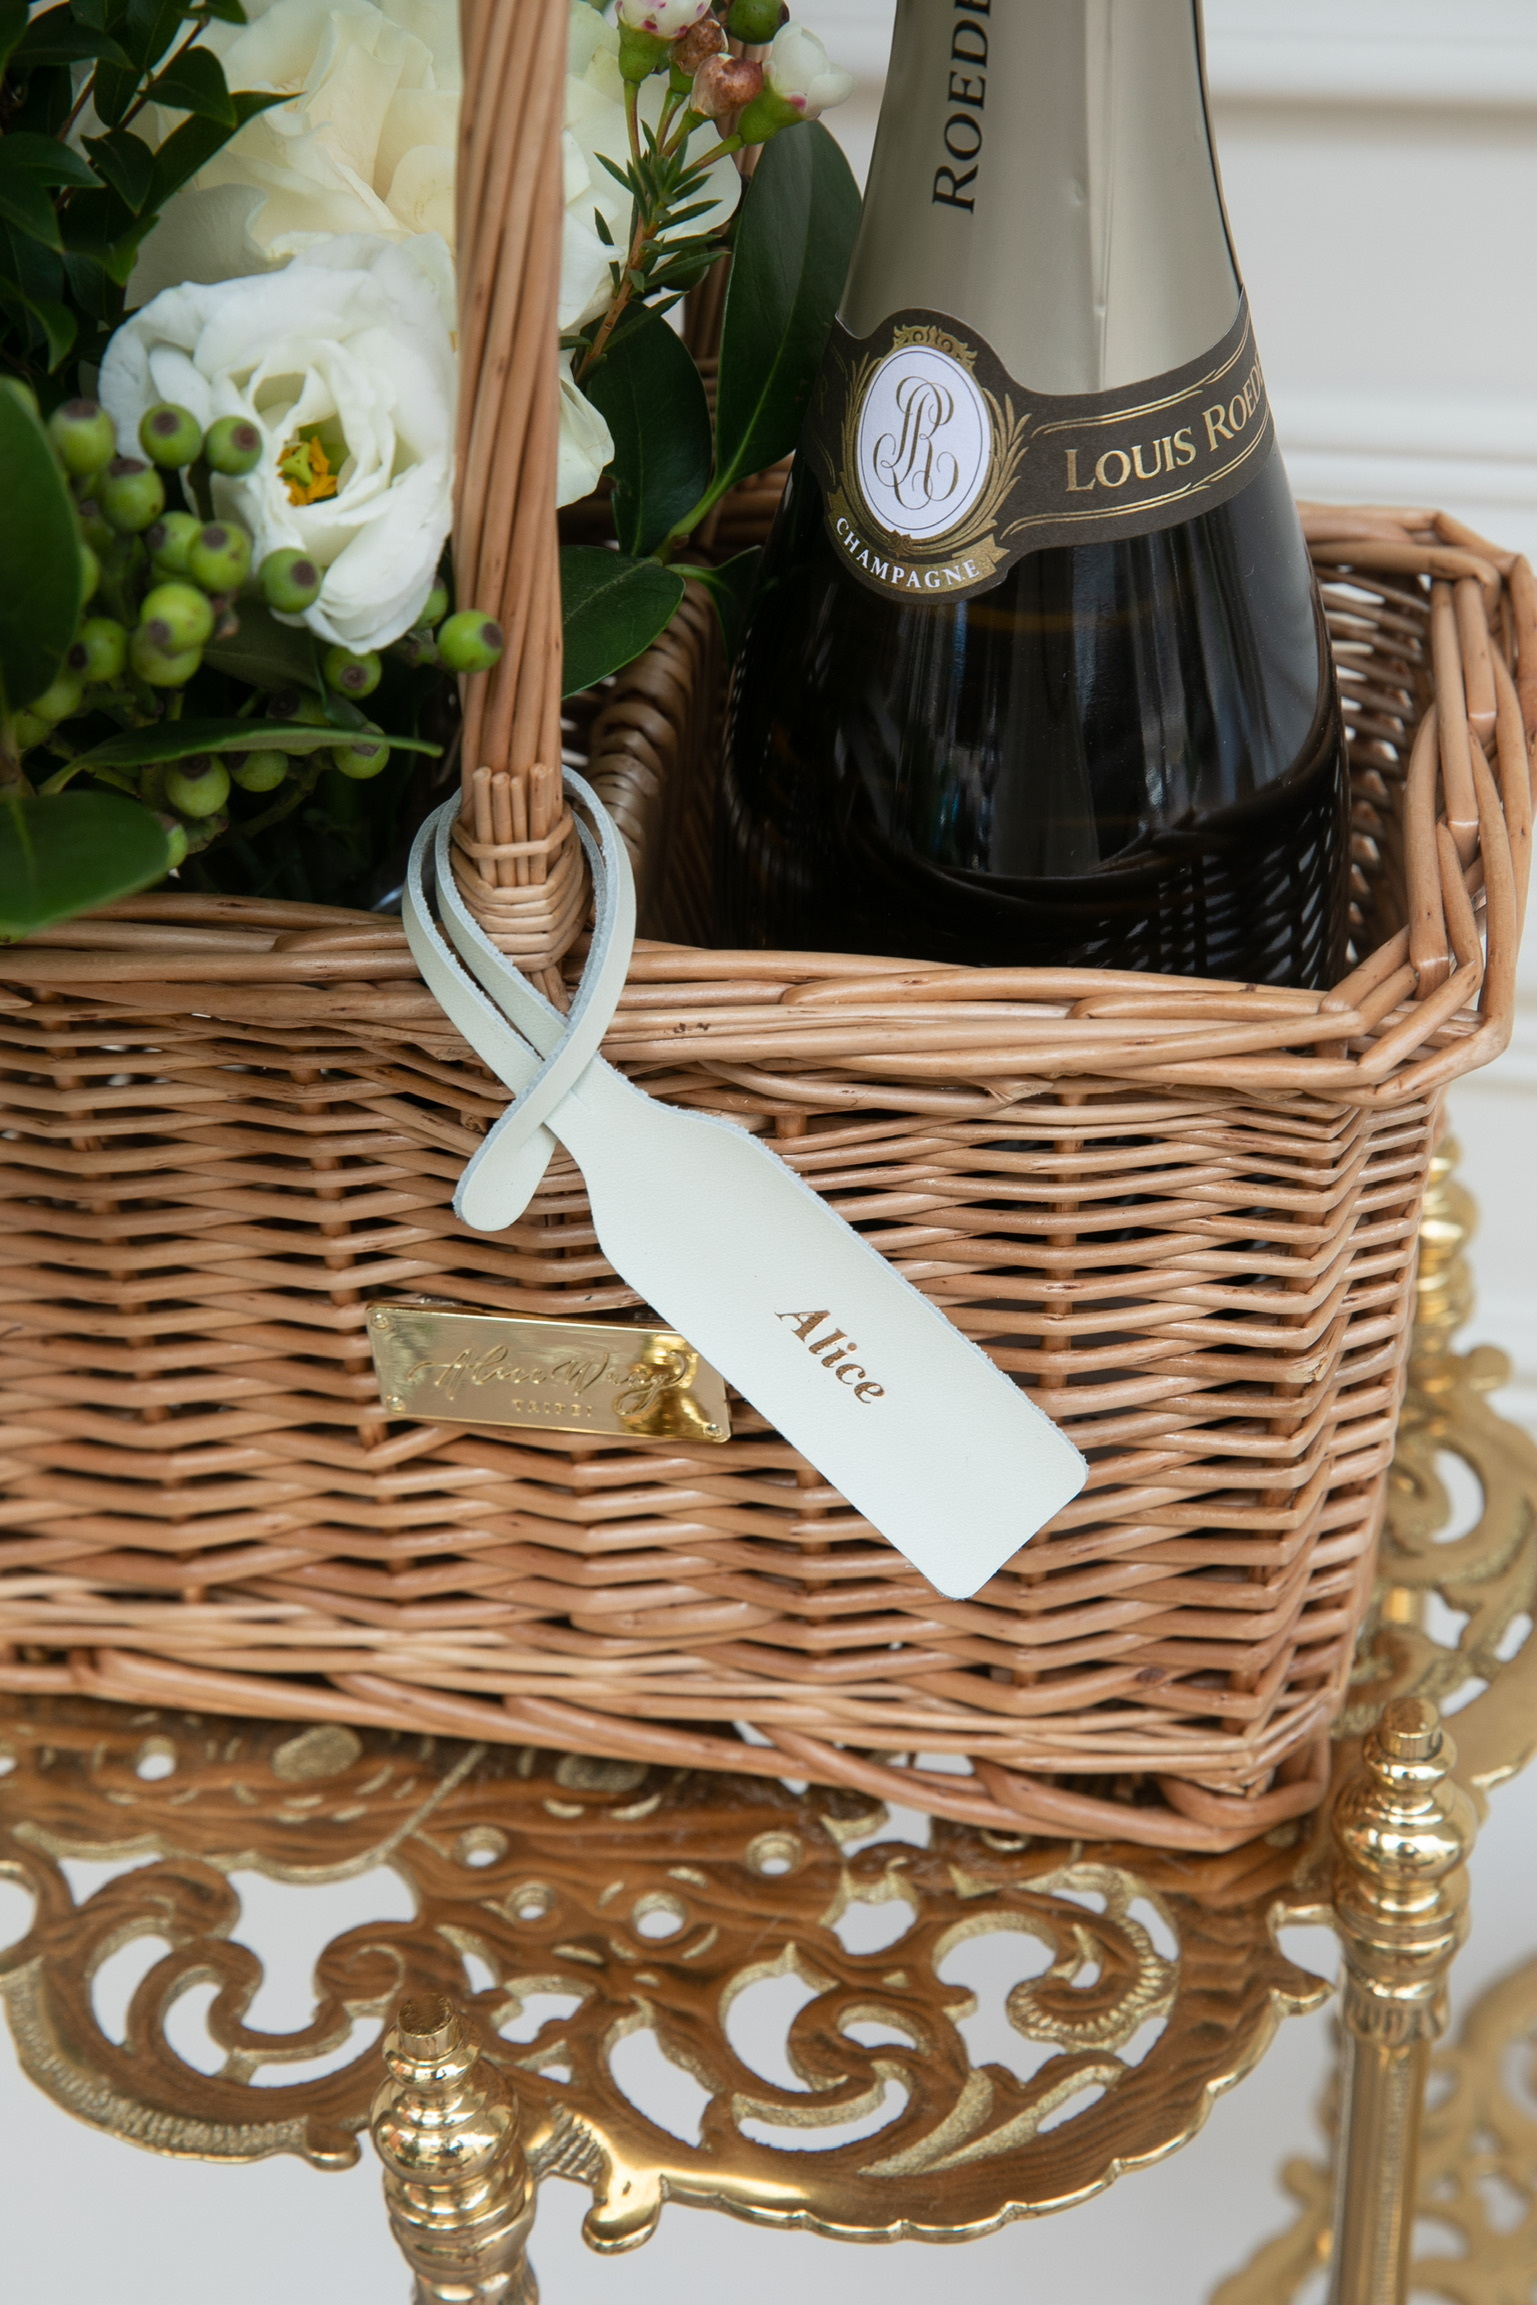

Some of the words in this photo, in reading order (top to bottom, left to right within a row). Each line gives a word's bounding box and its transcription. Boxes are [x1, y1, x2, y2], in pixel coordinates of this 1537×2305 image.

[1065, 426, 1197, 492] LOUIS
[836, 516, 980, 589] CHAMPAGNE
[773, 1309, 885, 1404] Alice
